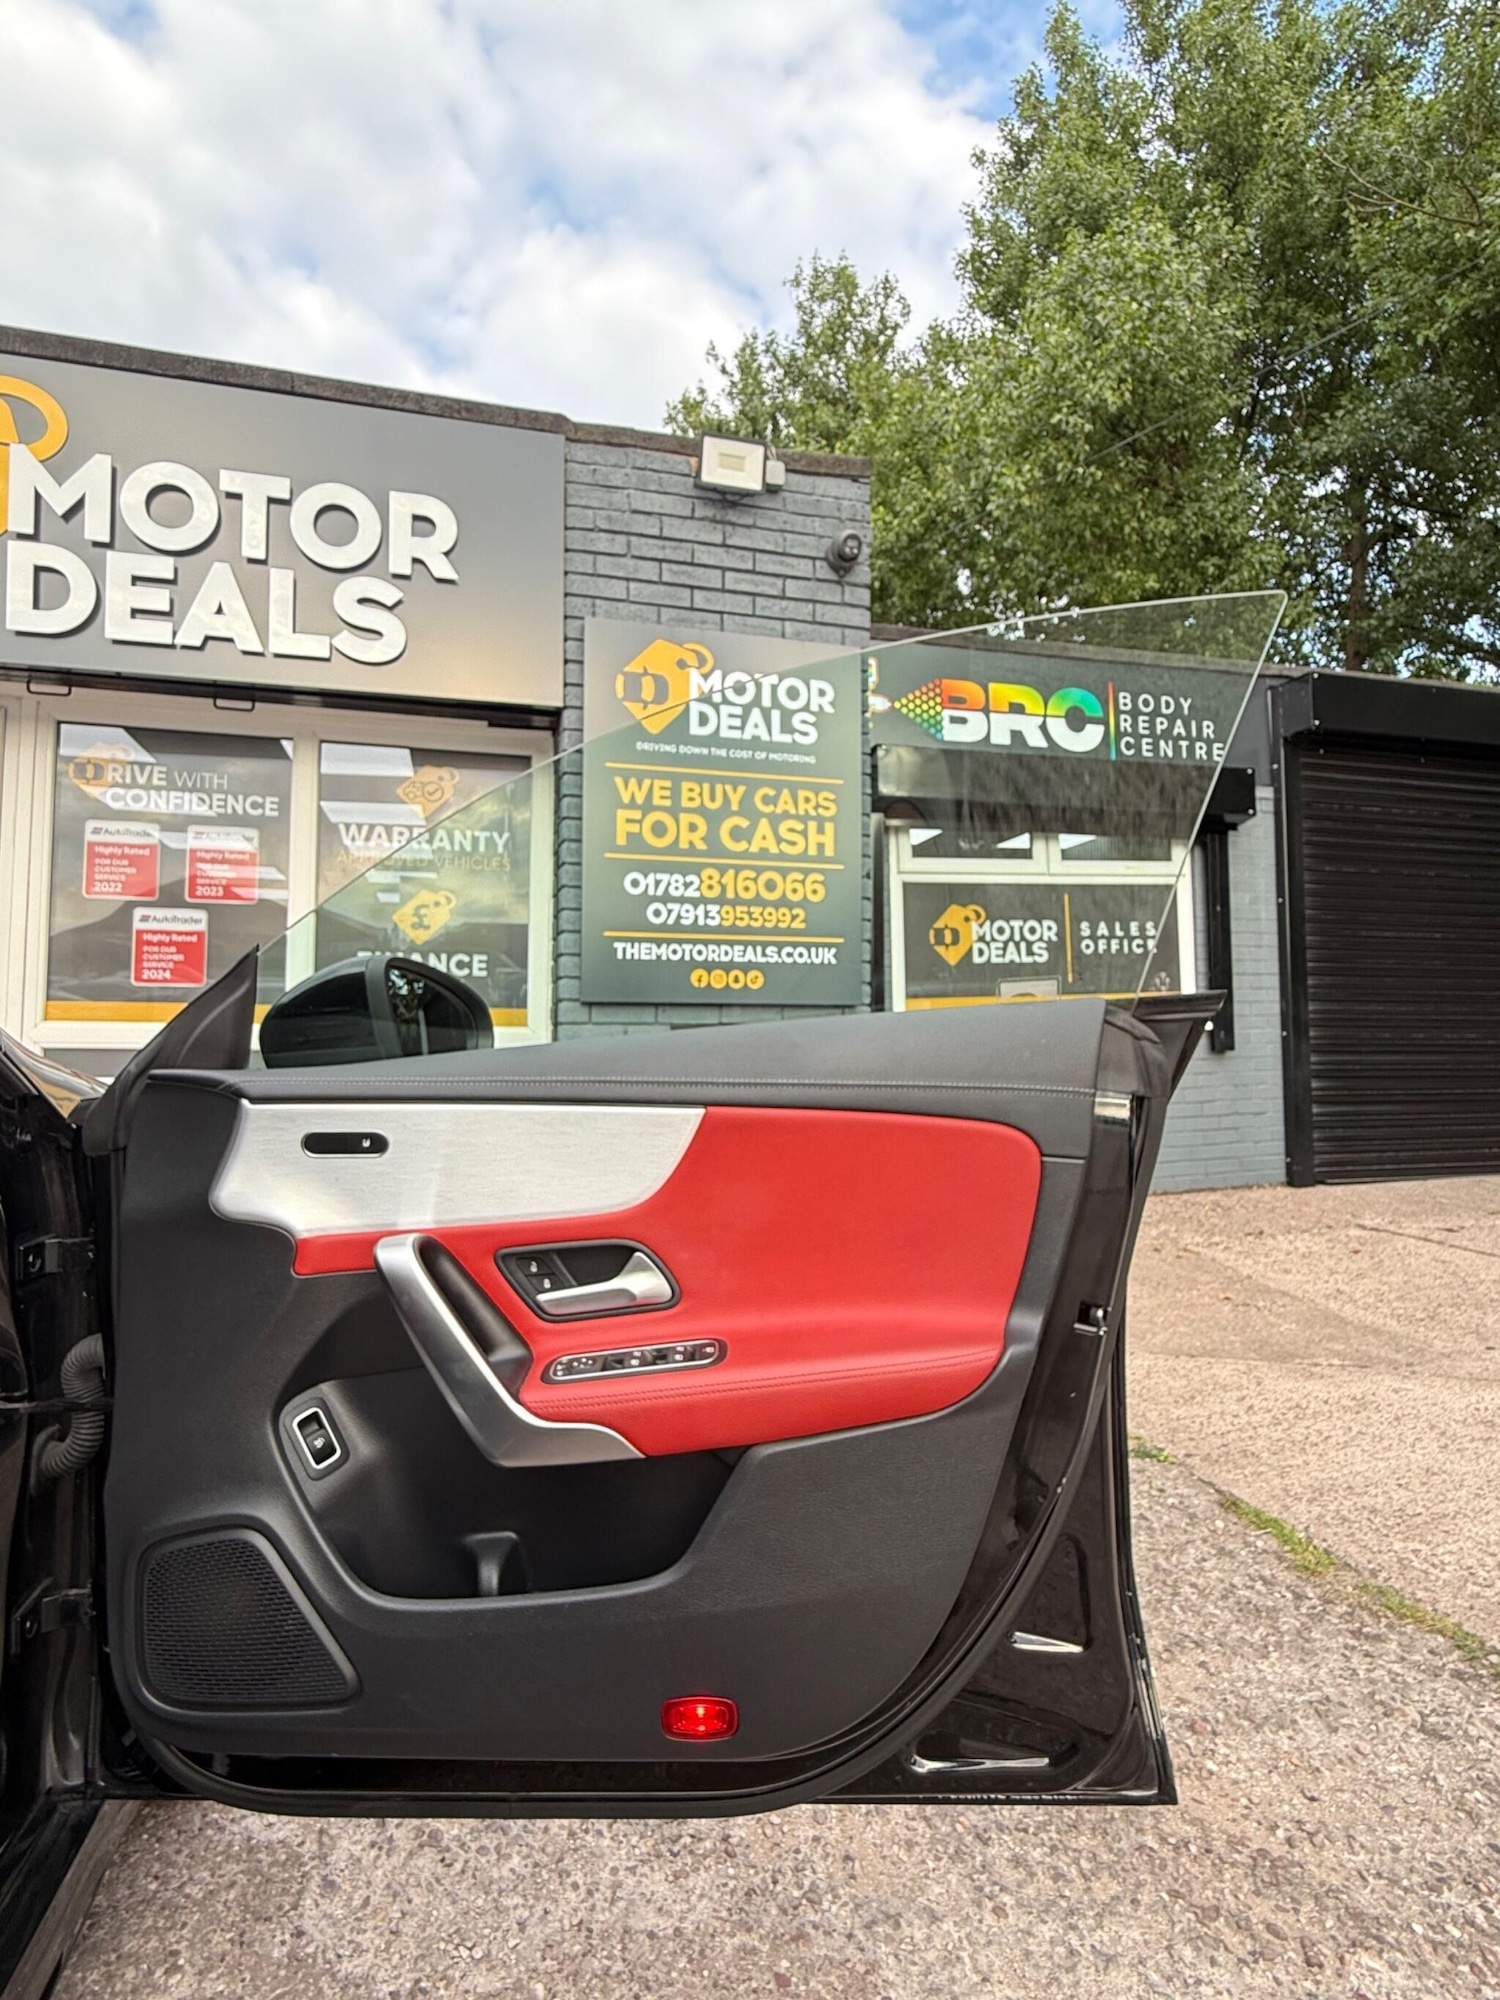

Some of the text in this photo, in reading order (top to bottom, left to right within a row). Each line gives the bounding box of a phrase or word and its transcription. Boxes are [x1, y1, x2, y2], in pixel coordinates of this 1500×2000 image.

[8, 443, 460, 583] MOTOR
[6, 540, 408, 665] DEALS
[689, 667, 835, 713] MOTOR
[941, 678, 1105, 752] BRC
[1118, 691, 1192, 716] BODY
[689, 700, 818, 745] DEALS
[1119, 714, 1215, 740] REPAIR
[635, 741, 817, 765] DRIVING DOWN THE COST OF MOTORING
[1120, 736, 1225, 762] CENTRE
[174, 770, 228, 790] WITH
[105, 787, 280, 817] CONFIDENCE
[614, 776, 838, 817] WE BUY CARS
[338, 823, 511, 854] WARRANTY
[616, 808, 836, 857] FOR CASH
[435, 858, 511, 872] VEHICLES
[93, 881, 123, 893] 2022
[623, 867, 826, 903] 01782816066
[645, 902, 807, 929] 07913953992
[970, 918, 1059, 942] MOTOR
[1079, 920, 1158, 938] SALES
[612, 941, 838, 965] THEMOTORDEALS.CO.UK
[972, 941, 1050, 965] DEALS
[1080, 938, 1159, 956] OFFICE
[141, 968, 172, 980] 2024
